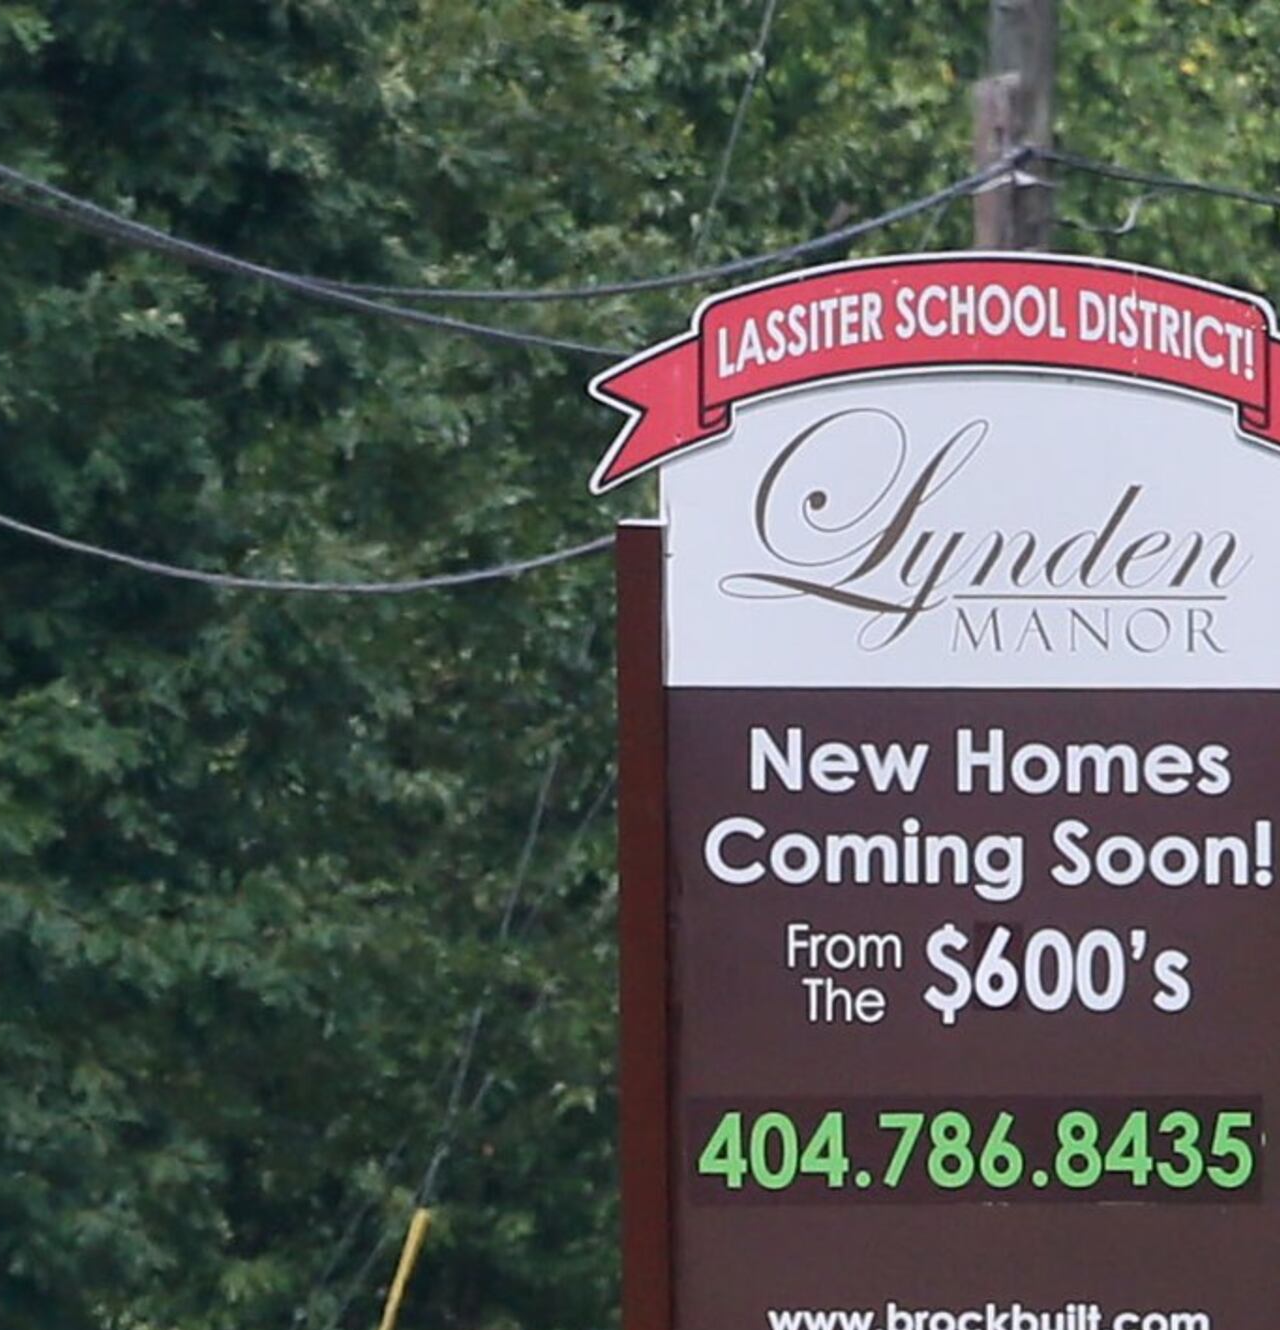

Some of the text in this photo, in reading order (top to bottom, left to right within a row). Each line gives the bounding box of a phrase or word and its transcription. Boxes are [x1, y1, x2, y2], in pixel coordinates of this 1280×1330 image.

[716, 283, 1256, 381] LASSITER SCHOOL DISTRICT!
[718, 407, 1253, 652] Lynden
[950, 607, 1229, 654] MANOR
[750, 727, 1231, 795] New Homes
[704, 817, 1273, 901] Coming Soon!
[788, 923, 902, 969] From
[923, 923, 1191, 1025] $600's
[802, 977, 886, 1023] The
[698, 1111, 1254, 1189] 404.786.8435
